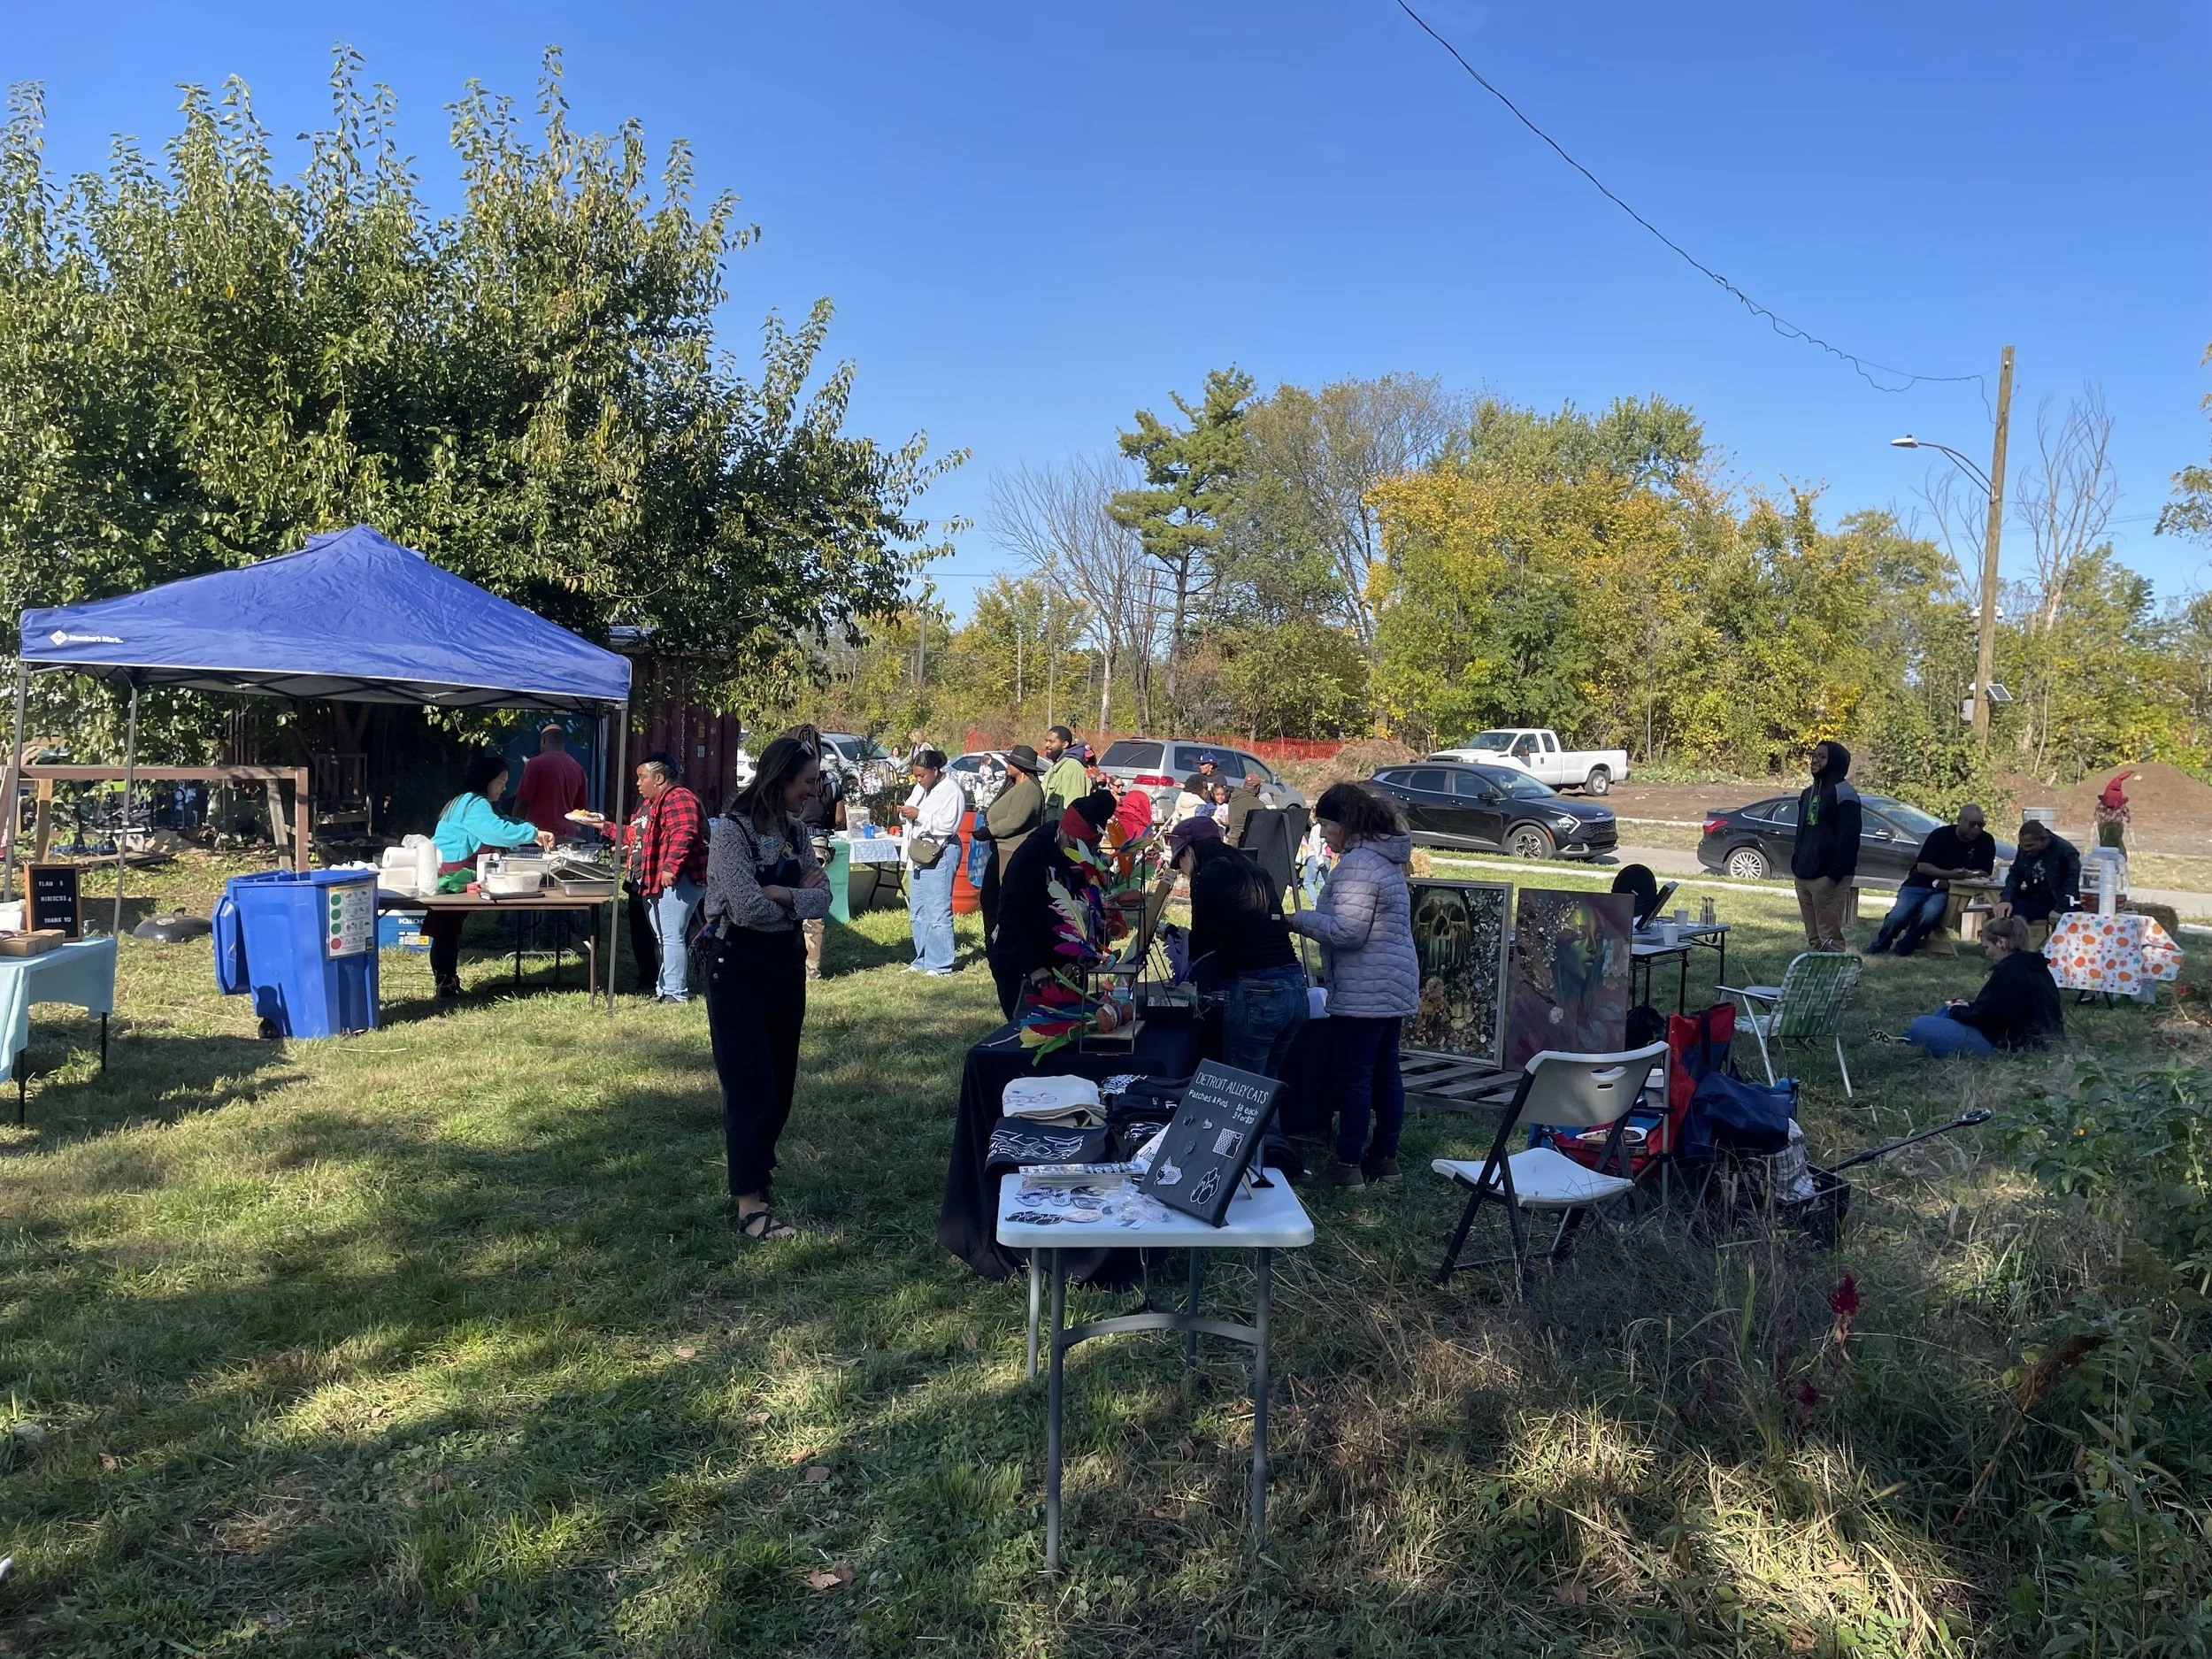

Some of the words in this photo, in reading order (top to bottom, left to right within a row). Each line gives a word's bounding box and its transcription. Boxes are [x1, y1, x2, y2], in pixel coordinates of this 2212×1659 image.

[1195, 1071, 1228, 1091] DETROIT
[1225, 1081, 1249, 1097] ALLEY
[1247, 1087, 1269, 1104] CATS
[1188, 1089, 1212, 1102] Patches
[1216, 1097, 1228, 1108] Pins
[1244, 1107, 1258, 1116] each
